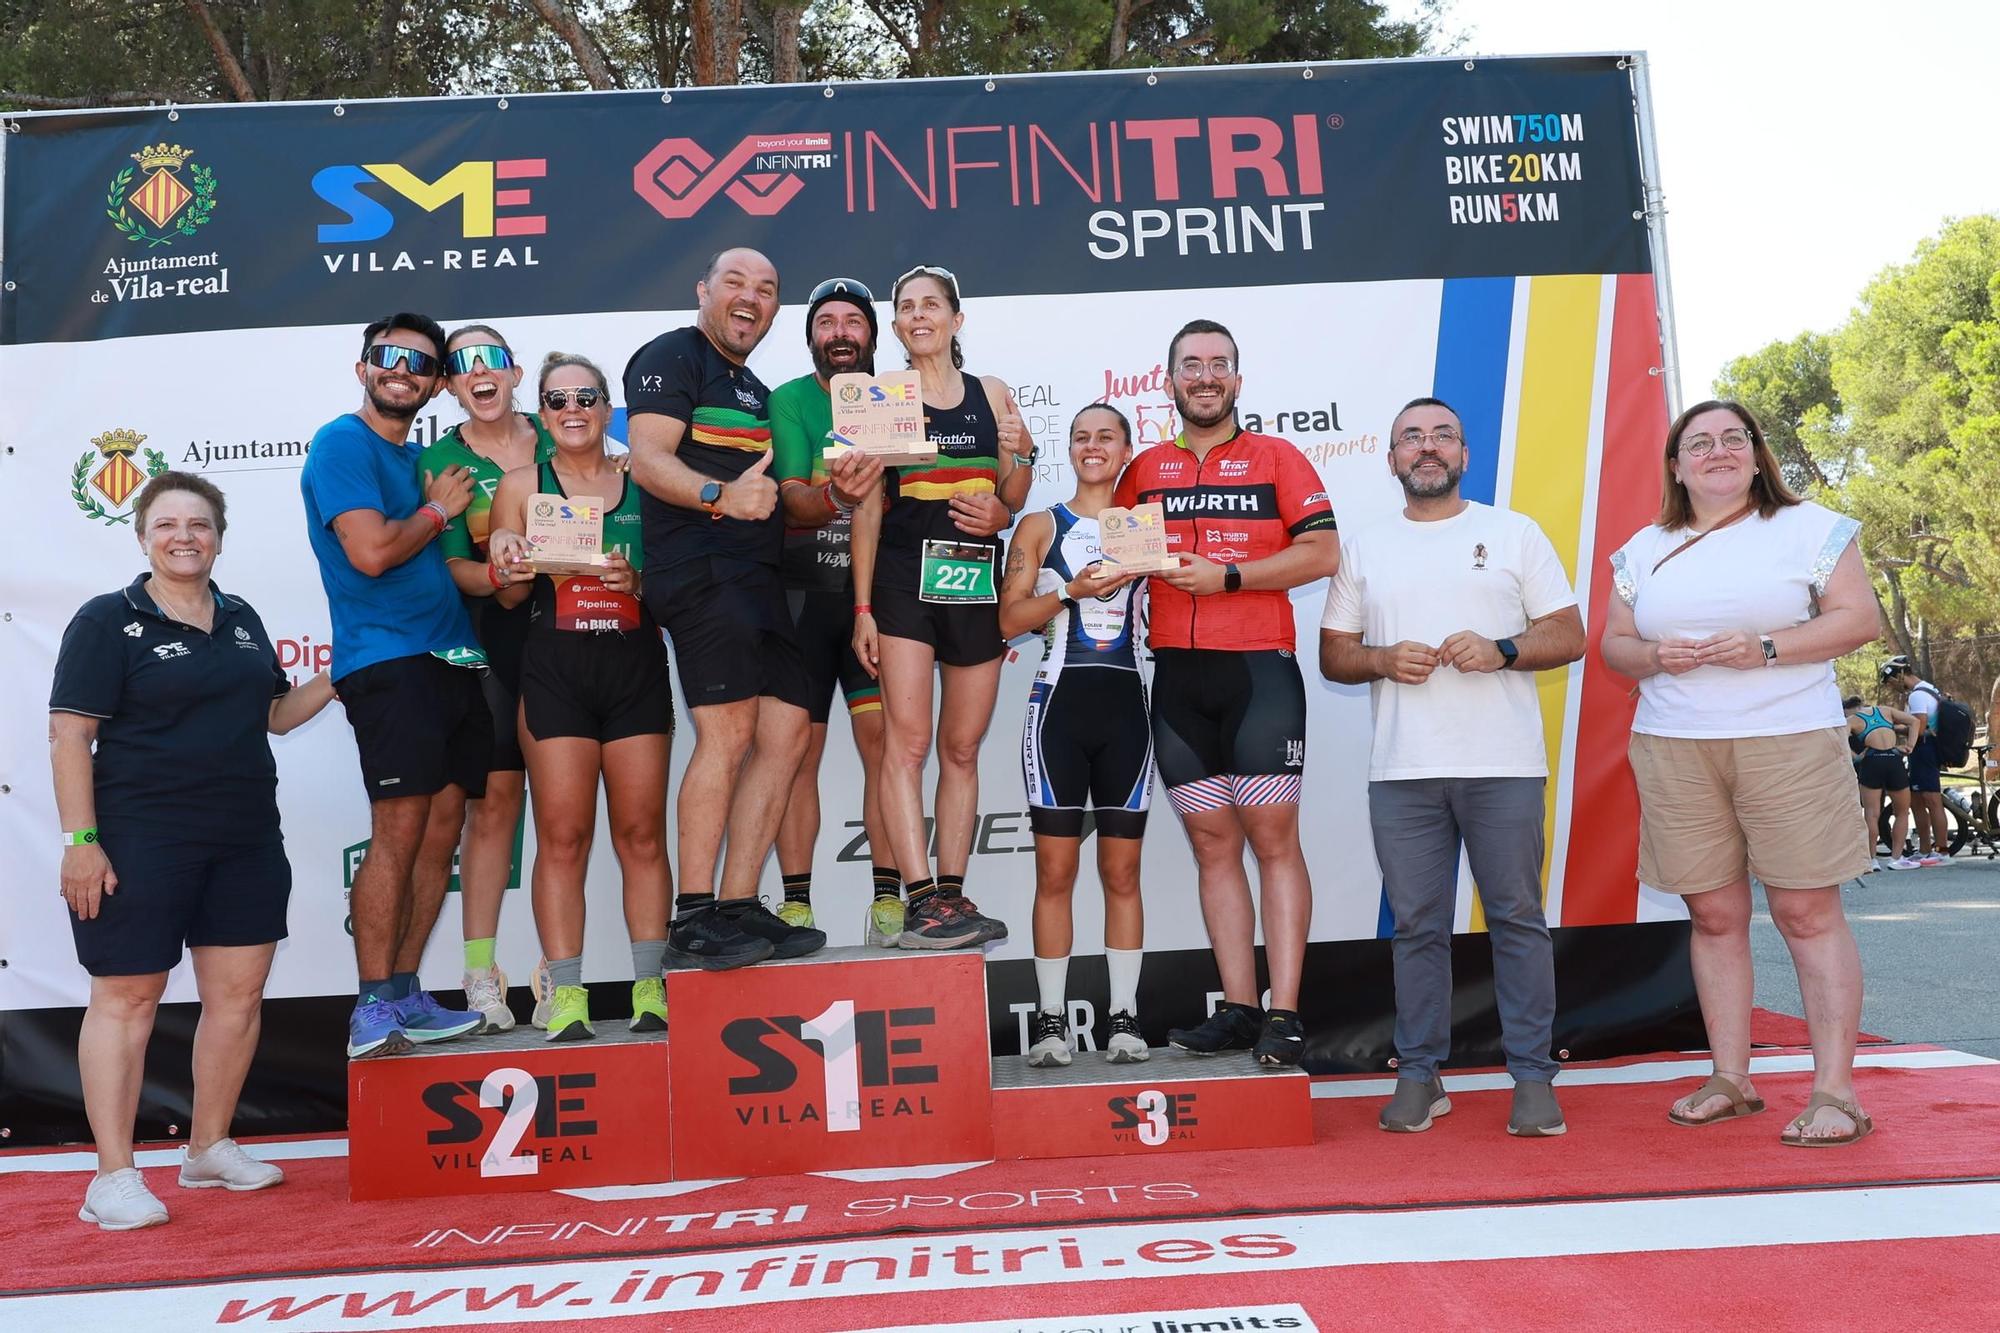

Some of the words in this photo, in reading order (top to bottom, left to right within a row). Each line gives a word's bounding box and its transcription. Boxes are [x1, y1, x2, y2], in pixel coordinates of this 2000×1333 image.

[757, 139, 786, 148] beyond
[787, 139, 803, 148] your
[805, 137, 829, 146] limits
[756, 154, 831, 170] INFINITRI
[845, 114, 1324, 212] INFINITRI
[311, 158, 547, 243] SME
[1087, 203, 1325, 259] SPRINT
[103, 251, 218, 278] Ajuntament
[323, 246, 539, 273] VILA-REAL
[91, 290, 109, 303] de
[108, 268, 230, 302] Vila-real
[868, 384, 916, 401] SME
[560, 505, 599, 520] SME
[935, 565, 981, 591] 227
[575, 618, 588, 630] in
[590, 619, 619, 630] BIKE
[800, 1000, 860, 1132] 1
[479, 1067, 539, 1178] 2
[1137, 1090, 1169, 1146] 3
[412, 1205, 808, 1248] INFINITRI
[844, 1183, 1199, 1217] SPORTS
[216, 1233, 1297, 1323] www.infinitri.es
[1152, 1316, 1302, 1333] limits
